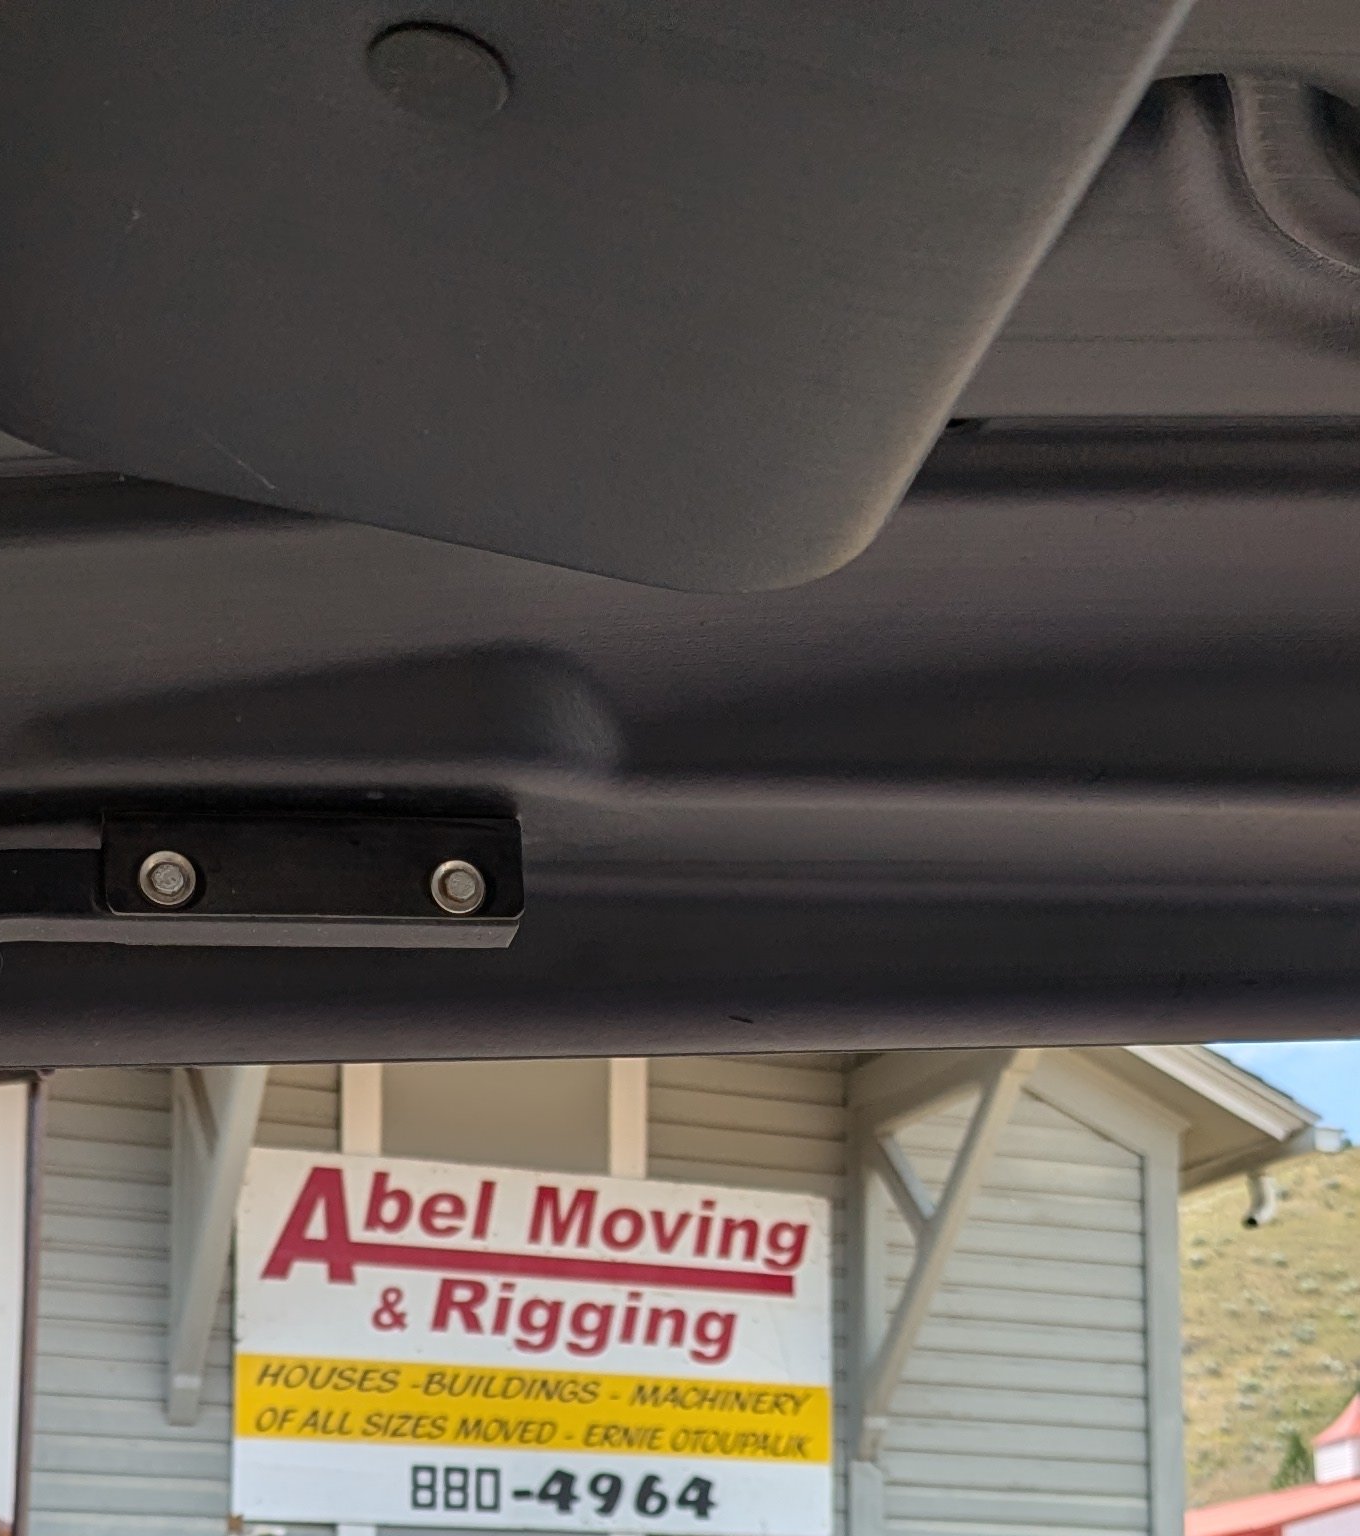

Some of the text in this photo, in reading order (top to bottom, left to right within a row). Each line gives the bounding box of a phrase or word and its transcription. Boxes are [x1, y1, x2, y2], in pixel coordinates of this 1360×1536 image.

[259, 1166, 810, 1285] Abel Moving
[371, 1278, 738, 1365] & Rigging
[256, 1363, 402, 1394] HOUSES
[629, 1384, 812, 1418] MACHINERY
[254, 1406, 299, 1433] OF
[300, 1409, 353, 1436] ALL
[361, 1412, 449, 1440] SIZES
[454, 1417, 558, 1447] MOVED
[582, 1423, 666, 1451] ERNIE
